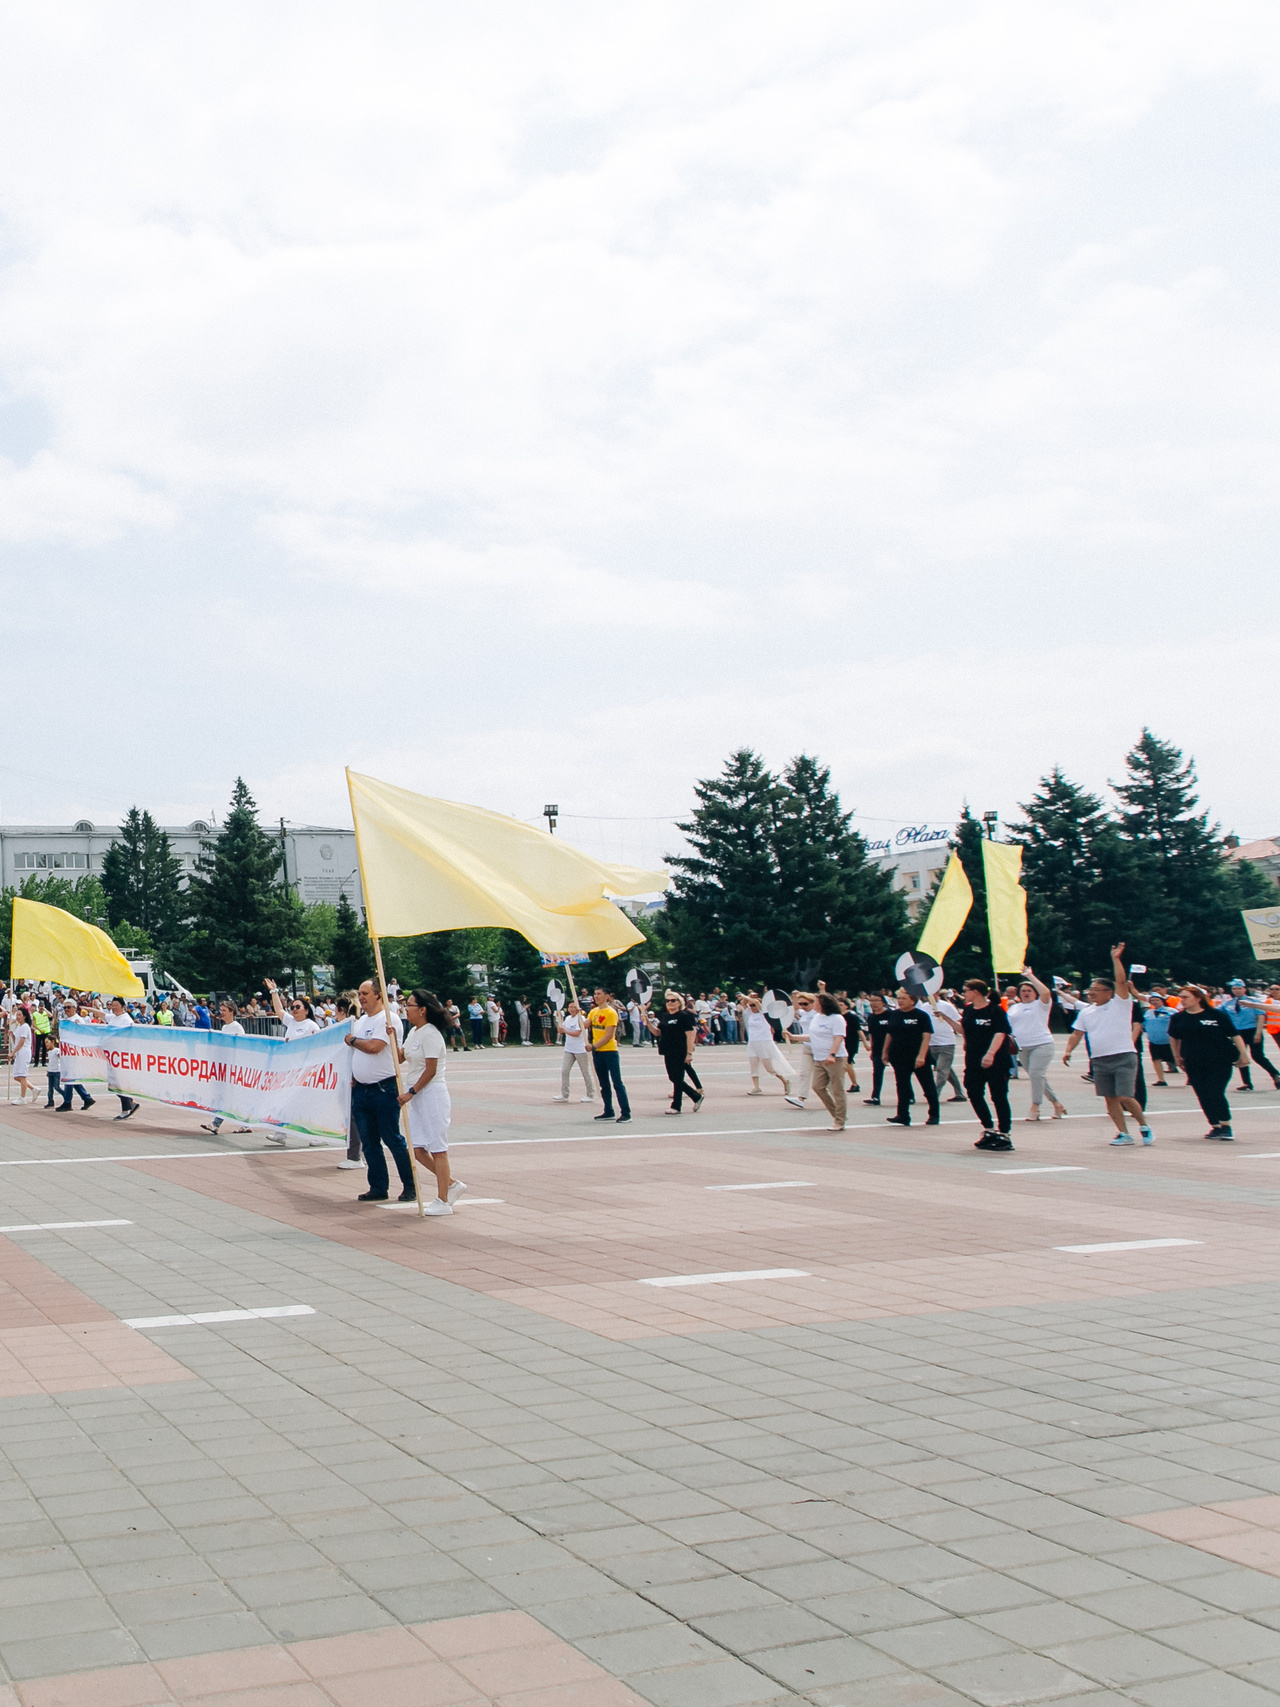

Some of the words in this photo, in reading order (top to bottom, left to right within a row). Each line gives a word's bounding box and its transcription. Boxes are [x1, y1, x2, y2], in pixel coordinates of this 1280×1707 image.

[896, 825, 949, 846] Plaza
[147, 1054, 227, 1083] РЕКОРДАМ
[230, 1064, 262, 1089] НАШИ
